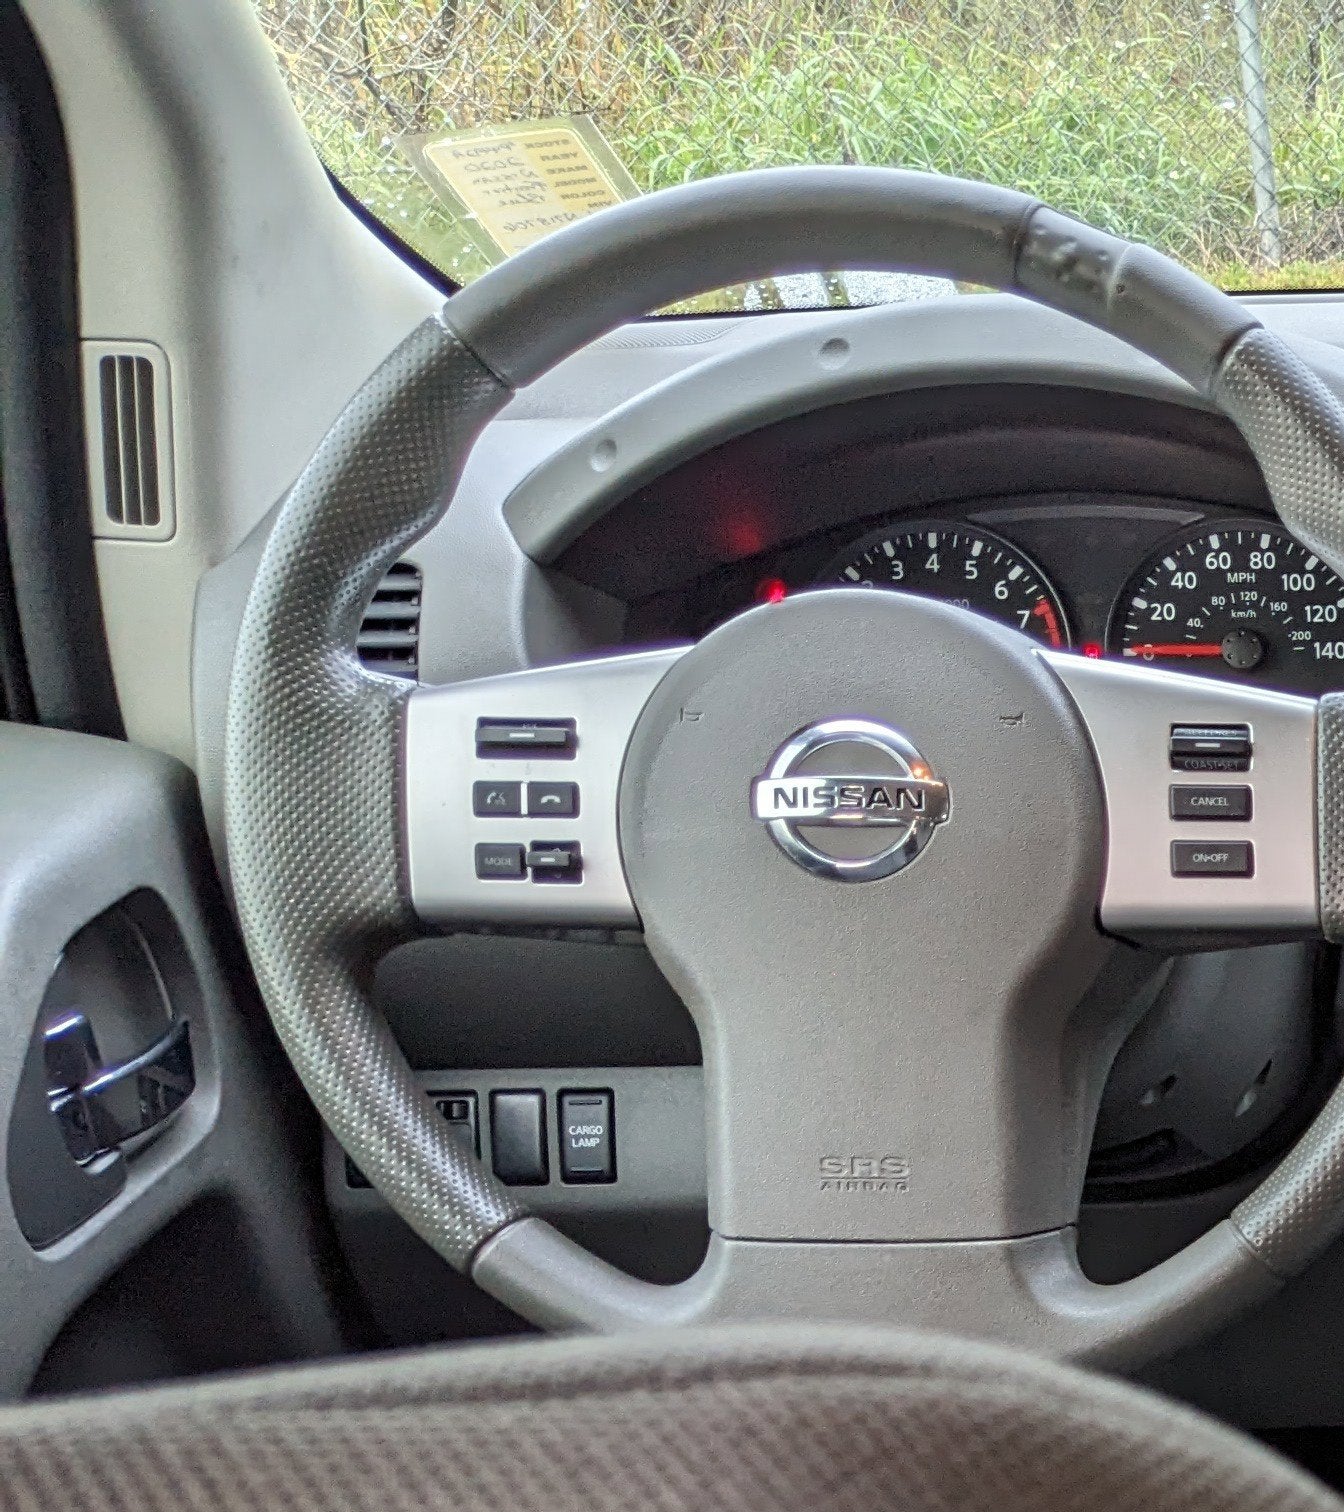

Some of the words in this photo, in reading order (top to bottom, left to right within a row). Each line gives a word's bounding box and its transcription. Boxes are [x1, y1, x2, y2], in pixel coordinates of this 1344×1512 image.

[925, 554, 940, 573] 4
[1205, 552, 1231, 569] 60
[1250, 552, 1276, 569] 80
[891, 561, 904, 580] 3
[965, 561, 978, 580] 5
[1227, 573, 1256, 583] MPH
[1171, 572, 1197, 589] 40
[1281, 573, 1315, 591] 100
[994, 581, 1008, 600] 6
[1240, 592, 1258, 601] 120
[1211, 596, 1226, 606] 80
[1270, 602, 1288, 612] 160
[1017, 610, 1030, 629] 7
[1150, 604, 1176, 620] 20
[1231, 609, 1257, 619] km/h
[1305, 605, 1337, 623] 120
[1187, 618, 1201, 628] 40
[1291, 631, 1311, 640] 200
[773, 785, 926, 812] NISSAN
[1190, 796, 1228, 806] CANCEL
[568, 1125, 603, 1135] CARGO
[572, 1138, 600, 1148] LAMP
[819, 1155, 912, 1176] SRS
